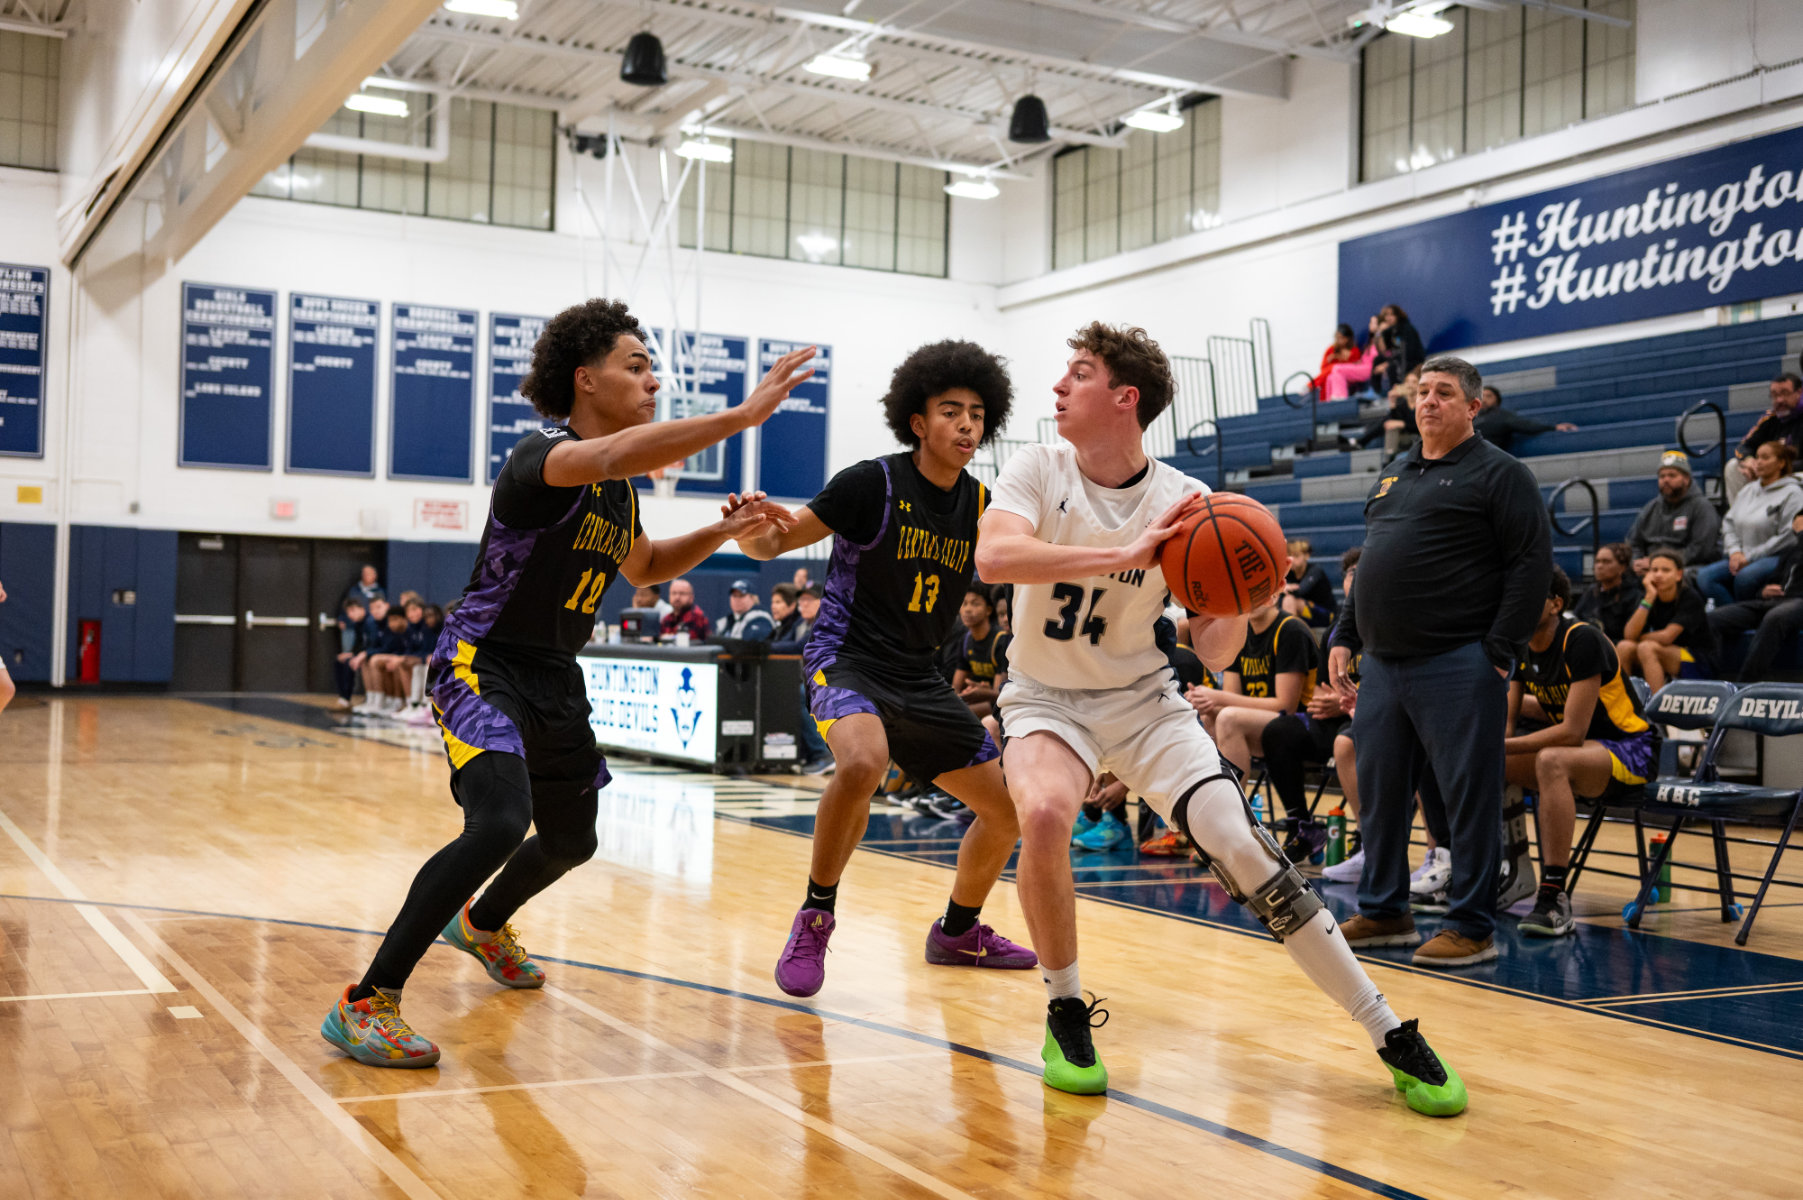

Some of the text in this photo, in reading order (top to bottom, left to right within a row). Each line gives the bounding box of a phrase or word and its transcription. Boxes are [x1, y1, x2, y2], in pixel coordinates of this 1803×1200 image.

[1491, 163, 1803, 266] #Huntingto
[1490, 221, 1803, 317] #Huntingto
[897, 525, 970, 574] CENTRAL ISLIP
[1235, 540, 1266, 580] THE
[907, 571, 940, 614] 13
[1043, 581, 1108, 646] 34
[590, 663, 660, 695] HUNTINGTON
[619, 700, 658, 734] DEVILS
[1658, 694, 1720, 715] DEVILS
